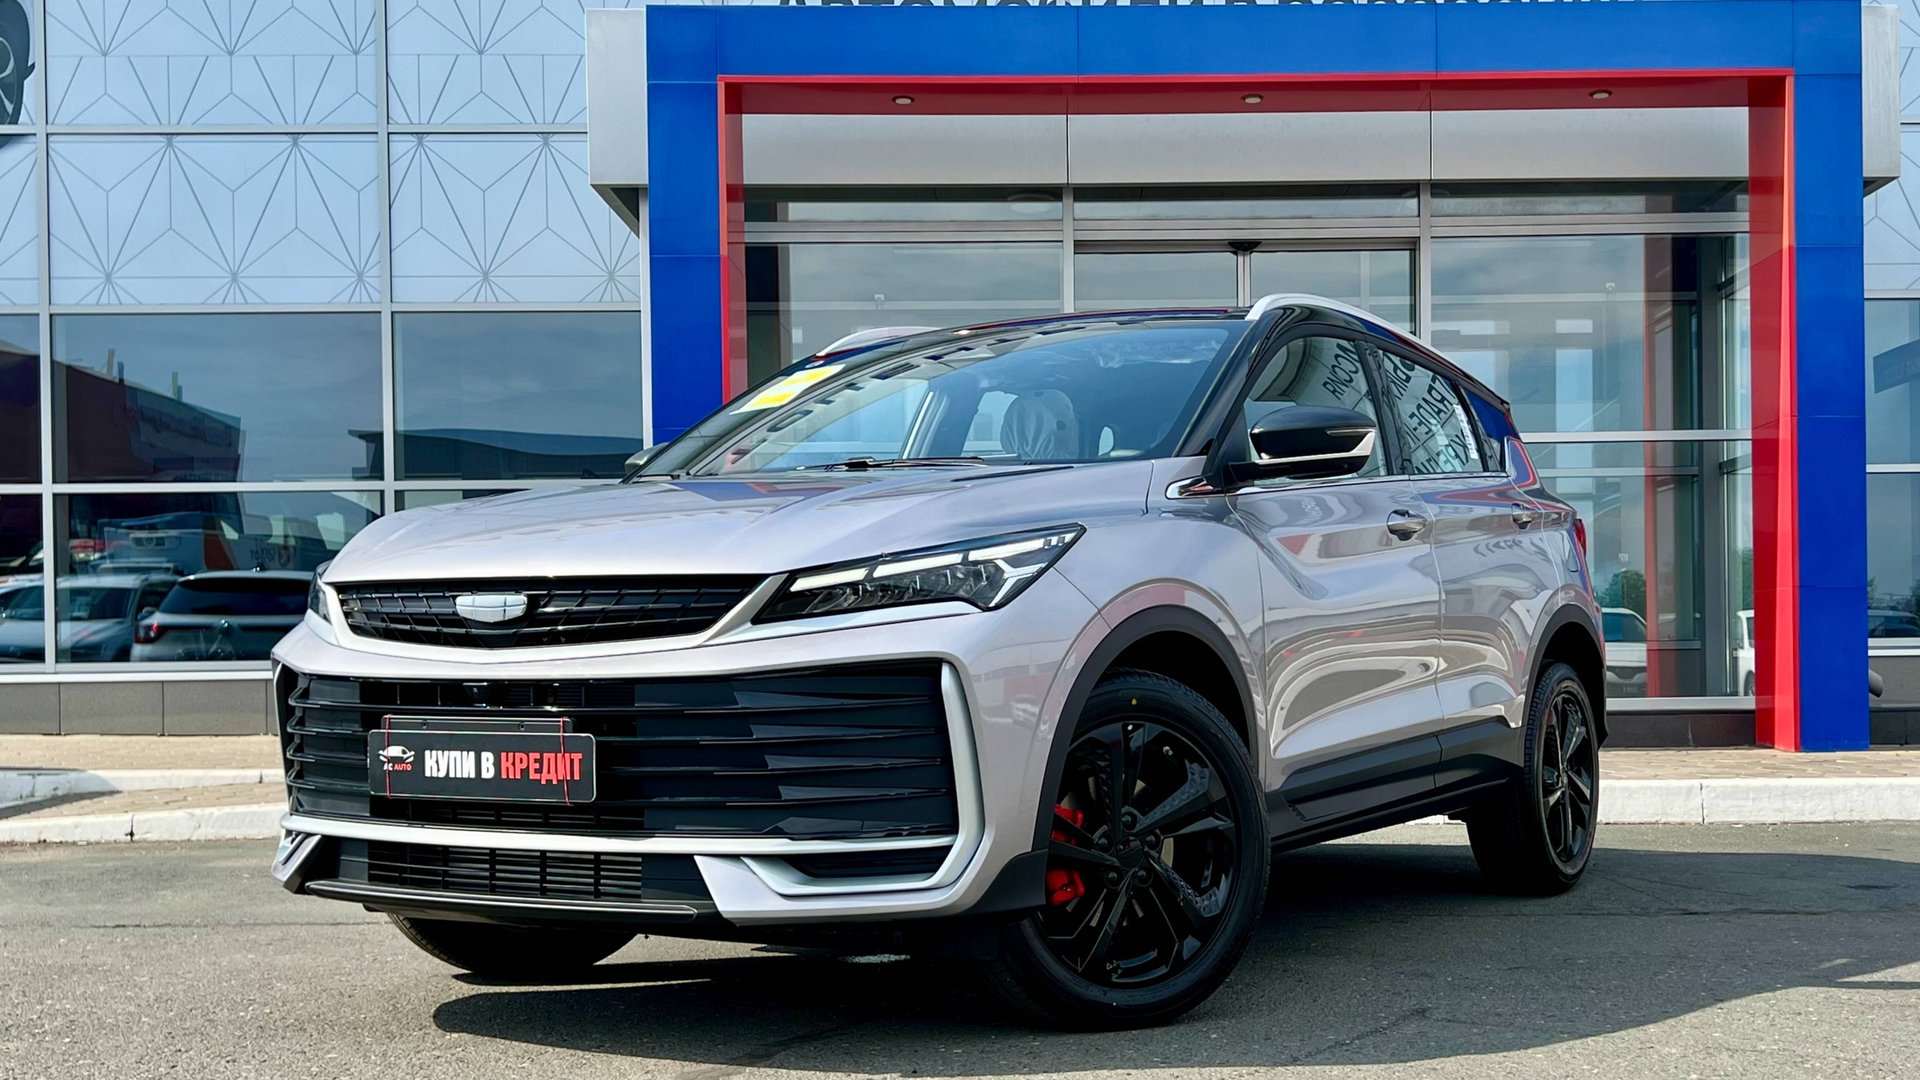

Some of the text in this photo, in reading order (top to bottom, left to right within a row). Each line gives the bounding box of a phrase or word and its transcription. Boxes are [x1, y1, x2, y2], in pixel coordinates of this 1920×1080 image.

[394, 763, 412, 771] AUTO
[424, 750, 583, 784] КУПИ В КРЕДИТ
